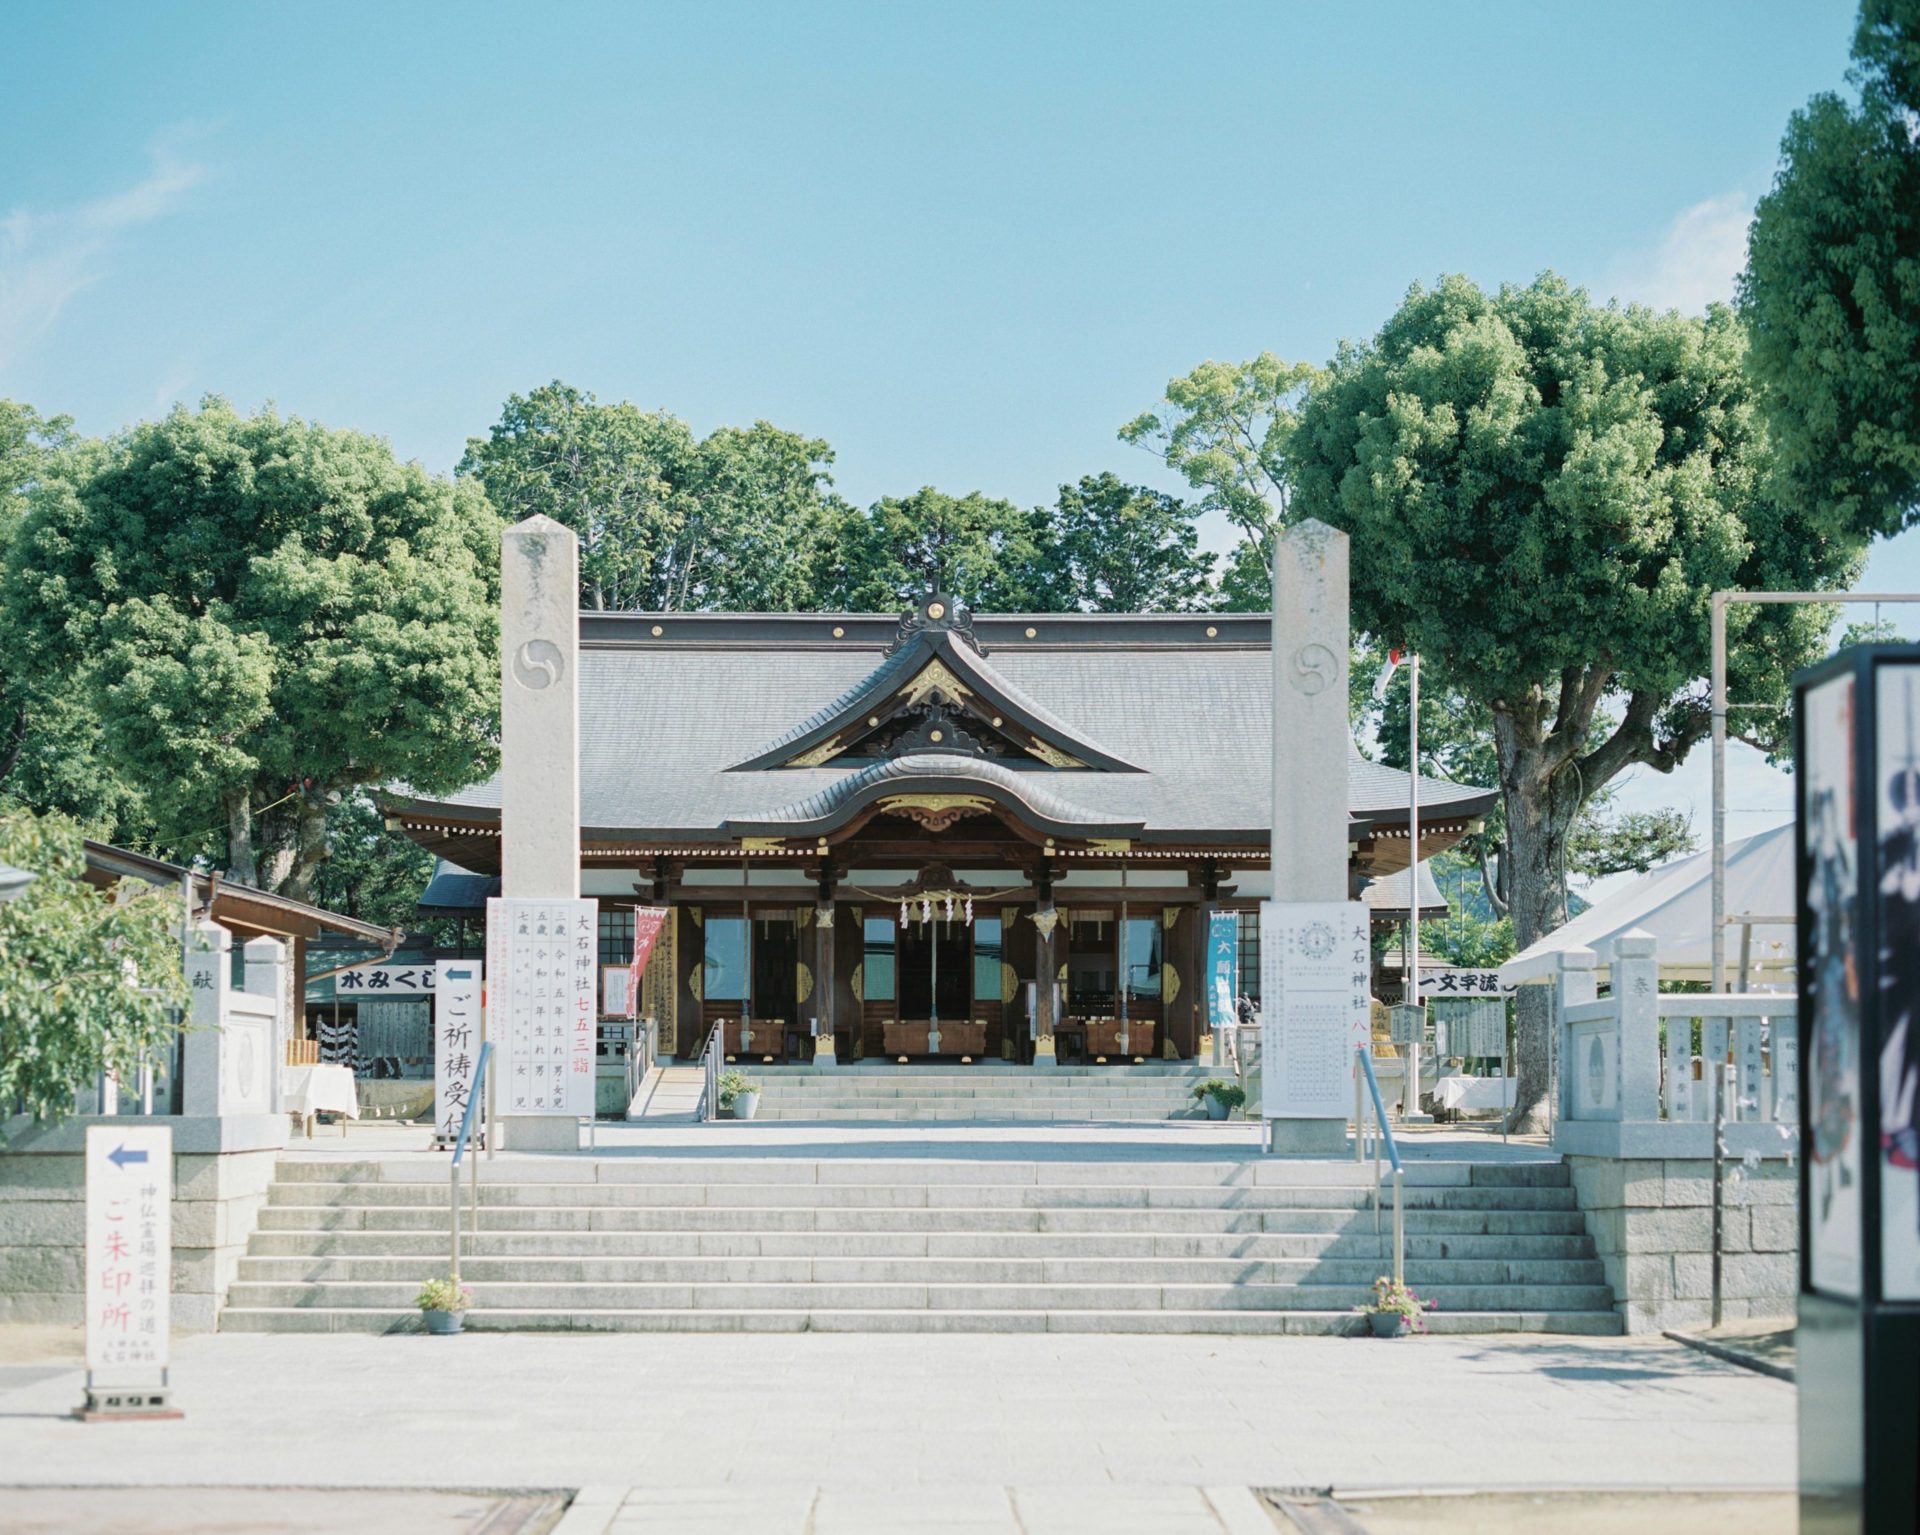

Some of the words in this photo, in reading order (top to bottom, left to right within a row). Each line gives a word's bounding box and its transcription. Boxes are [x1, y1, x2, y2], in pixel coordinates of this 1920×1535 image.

[192, 970, 213, 990] 献
[340, 969, 436, 989] 水みくじ
[573, 914, 592, 1073] 大石神社七五三詣
[1351, 925, 1368, 1079] 大石神社八
[1633, 976, 1650, 997] 奉
[443, 994, 472, 1133] ご祈祷受付
[100, 1199, 132, 1333] ご朱印所
